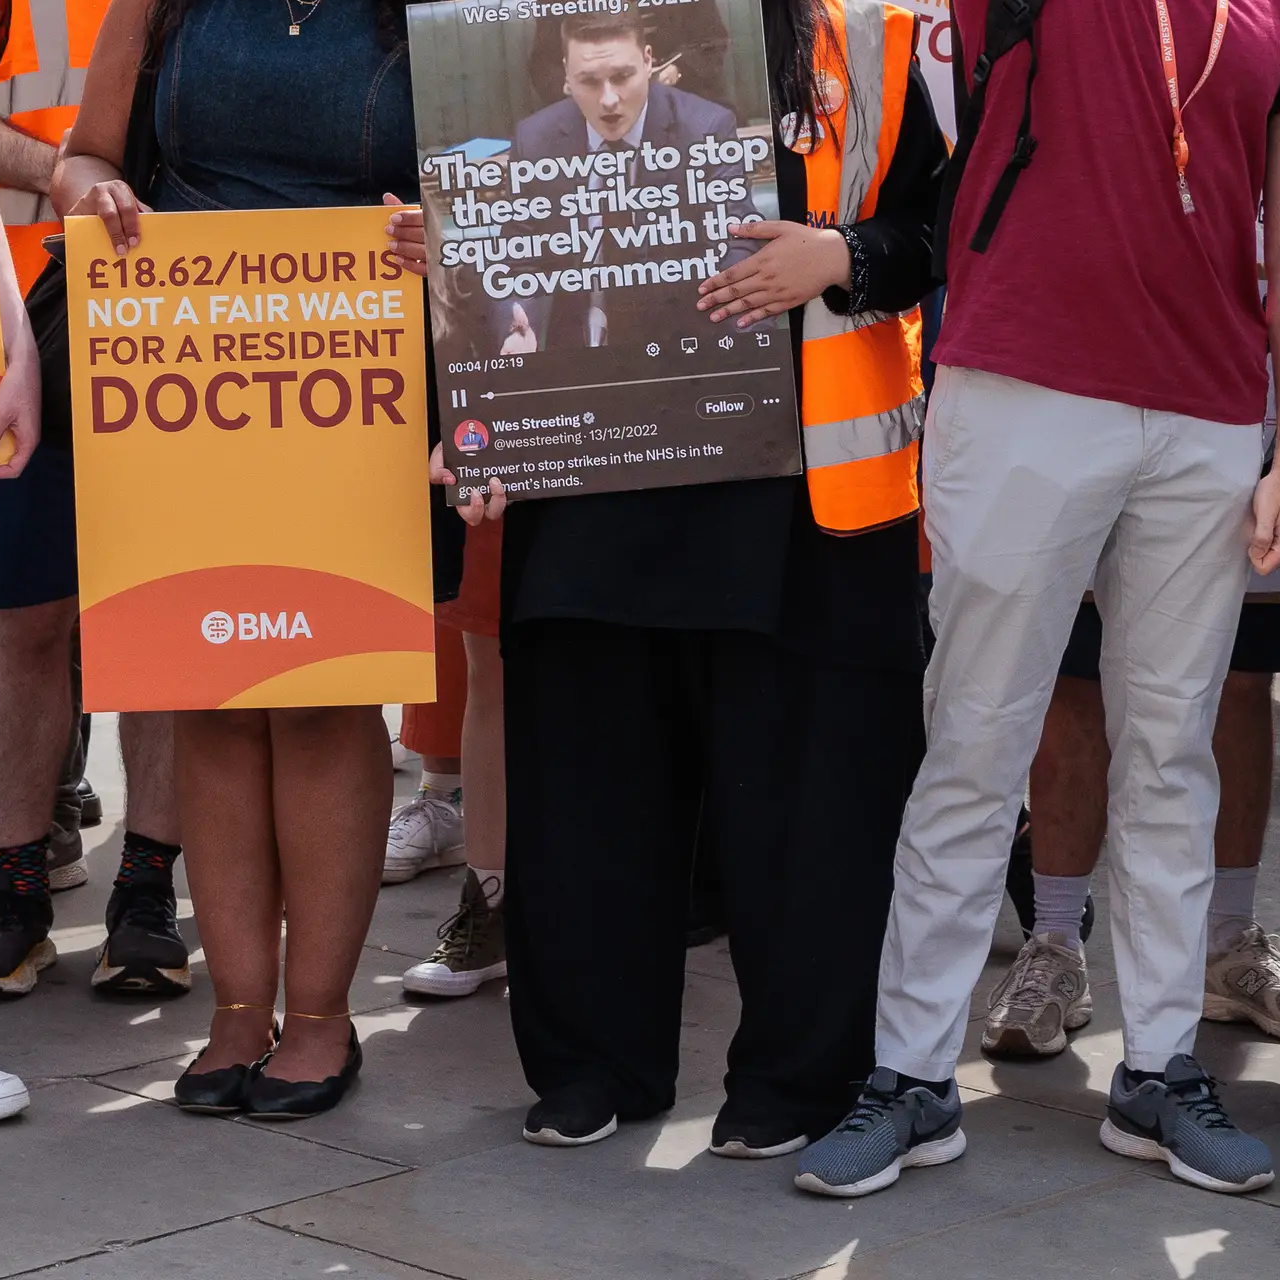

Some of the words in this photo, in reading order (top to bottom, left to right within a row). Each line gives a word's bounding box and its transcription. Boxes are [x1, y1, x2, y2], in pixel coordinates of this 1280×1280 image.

[463, 5, 510, 25] Wes
[1165, 46, 1173, 62] PAY
[510, 148, 635, 190] power
[641, 141, 681, 171] to
[688, 135, 768, 171] stop
[453, 190, 551, 227] these
[559, 180, 679, 216] strikes
[686, 171, 747, 204] lies
[441, 222, 604, 271] squarely
[610, 213, 694, 249] with
[86, 250, 357, 288] £18.62/HOUR
[368, 250, 404, 281] IS
[87, 297, 165, 328] NOT
[172, 297, 200, 325] A
[208, 293, 289, 324] FAIR
[298, 290, 404, 321] WAGE
[89, 335, 165, 366] FOR
[174, 335, 203, 363] A
[212, 329, 404, 361] RESIDENT
[449, 361, 482, 374] 00:04
[490, 356, 524, 370] 02:19
[91, 367, 407, 434] DOCTOR
[706, 400, 744, 414] Follow
[492, 419, 519, 433] Wes
[522, 413, 581, 431] Streeting
[493, 431, 582, 451] @wesstreeting
[589, 423, 658, 441] 13/12/2022
[458, 465, 480, 478] The
[483, 462, 520, 476] power
[523, 461, 536, 472] to
[537, 458, 565, 473] stop
[567, 454, 607, 468] strikes
[610, 453, 620, 464] in
[623, 451, 643, 463] the
[646, 447, 674, 462] NHS
[676, 447, 687, 458] is
[689, 445, 701, 457] in
[703, 443, 723, 456] the
[542, 475, 583, 489] hands.
[238, 611, 312, 641] BMA
